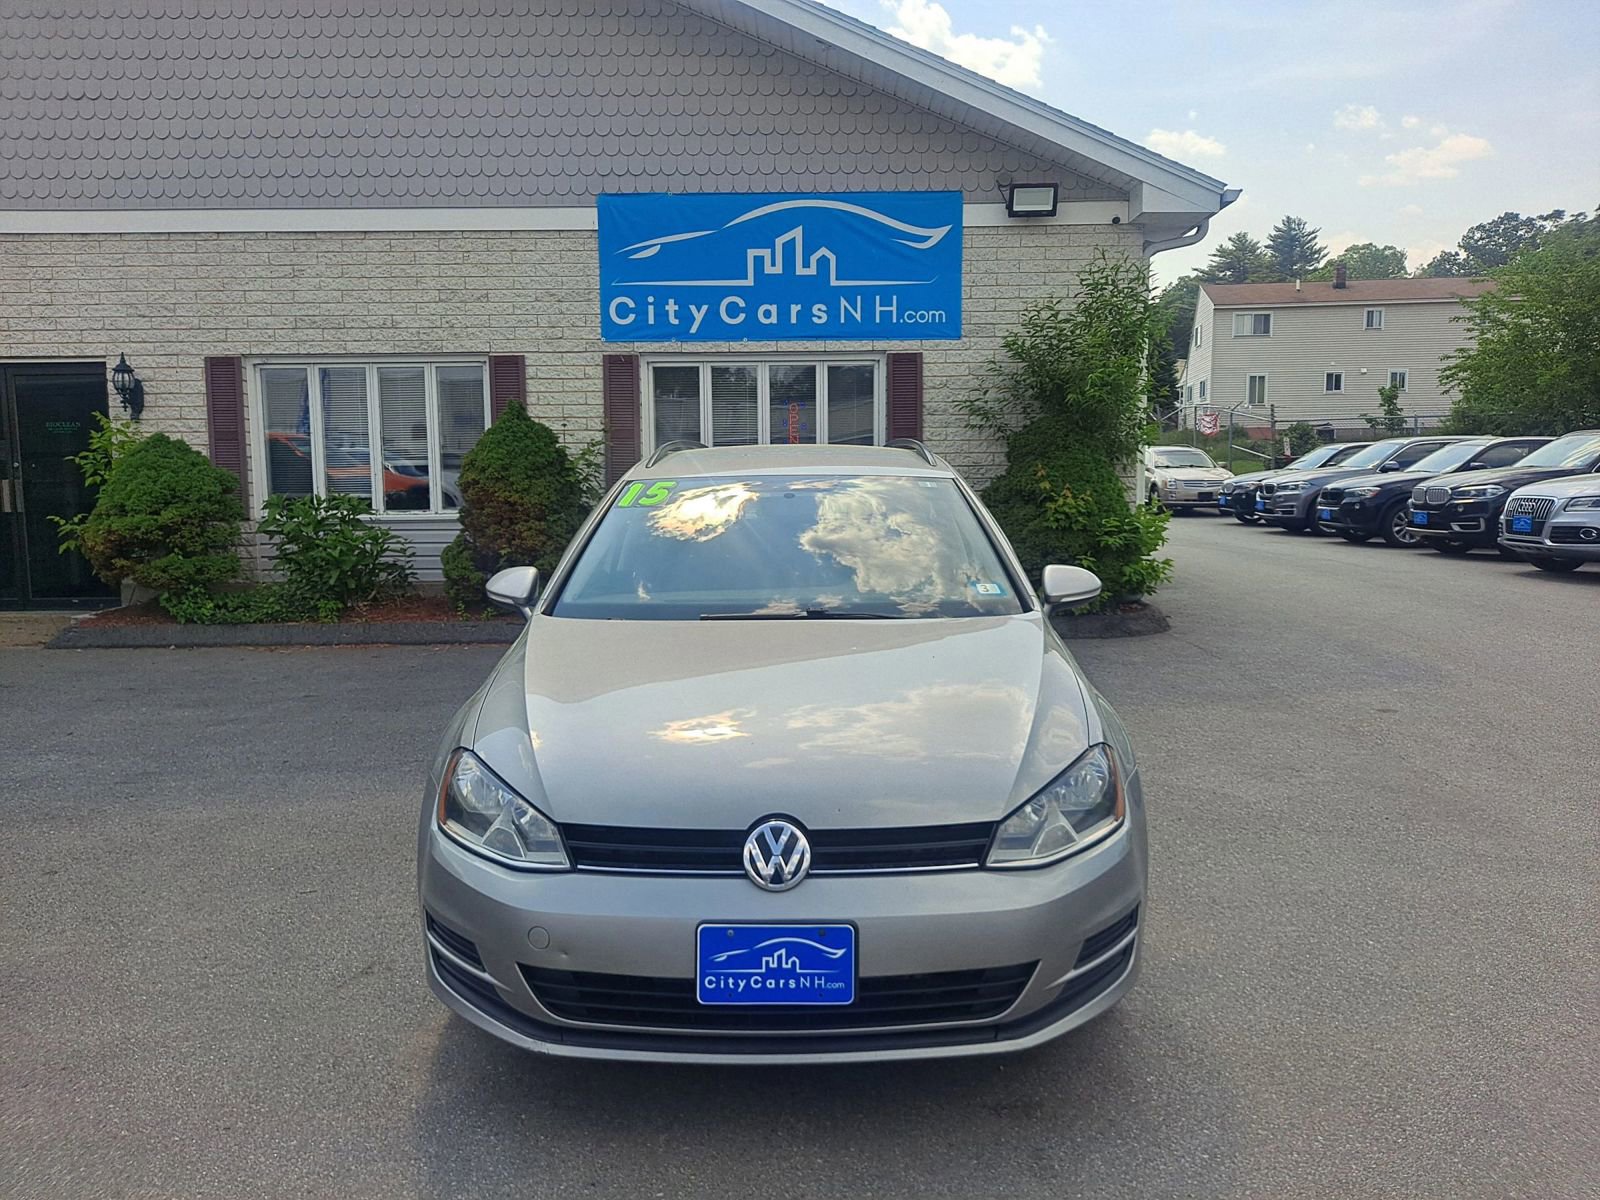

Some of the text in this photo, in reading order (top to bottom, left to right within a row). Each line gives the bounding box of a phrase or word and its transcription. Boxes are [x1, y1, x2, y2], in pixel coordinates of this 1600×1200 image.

[608, 295, 947, 333] CityCarsNH.com
[618, 481, 677, 507] 15
[704, 975, 846, 992] CityCarsNH.com
